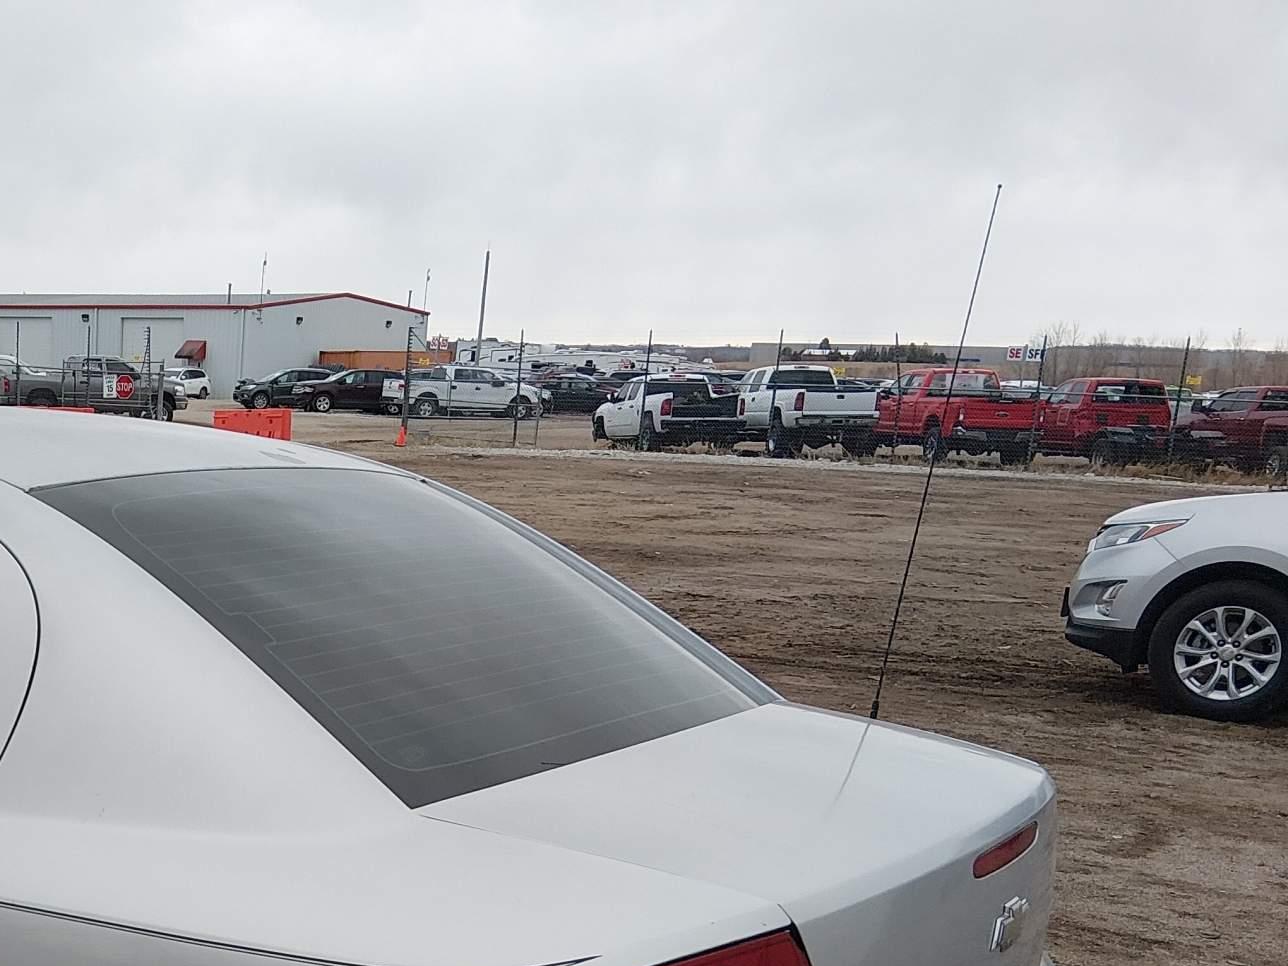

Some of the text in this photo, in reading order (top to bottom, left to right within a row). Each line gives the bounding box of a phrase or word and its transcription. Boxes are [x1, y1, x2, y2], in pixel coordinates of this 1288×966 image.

[1008, 348, 1022, 359] SE
[106, 384, 114, 393] 15
[116, 382, 133, 392] STOP
